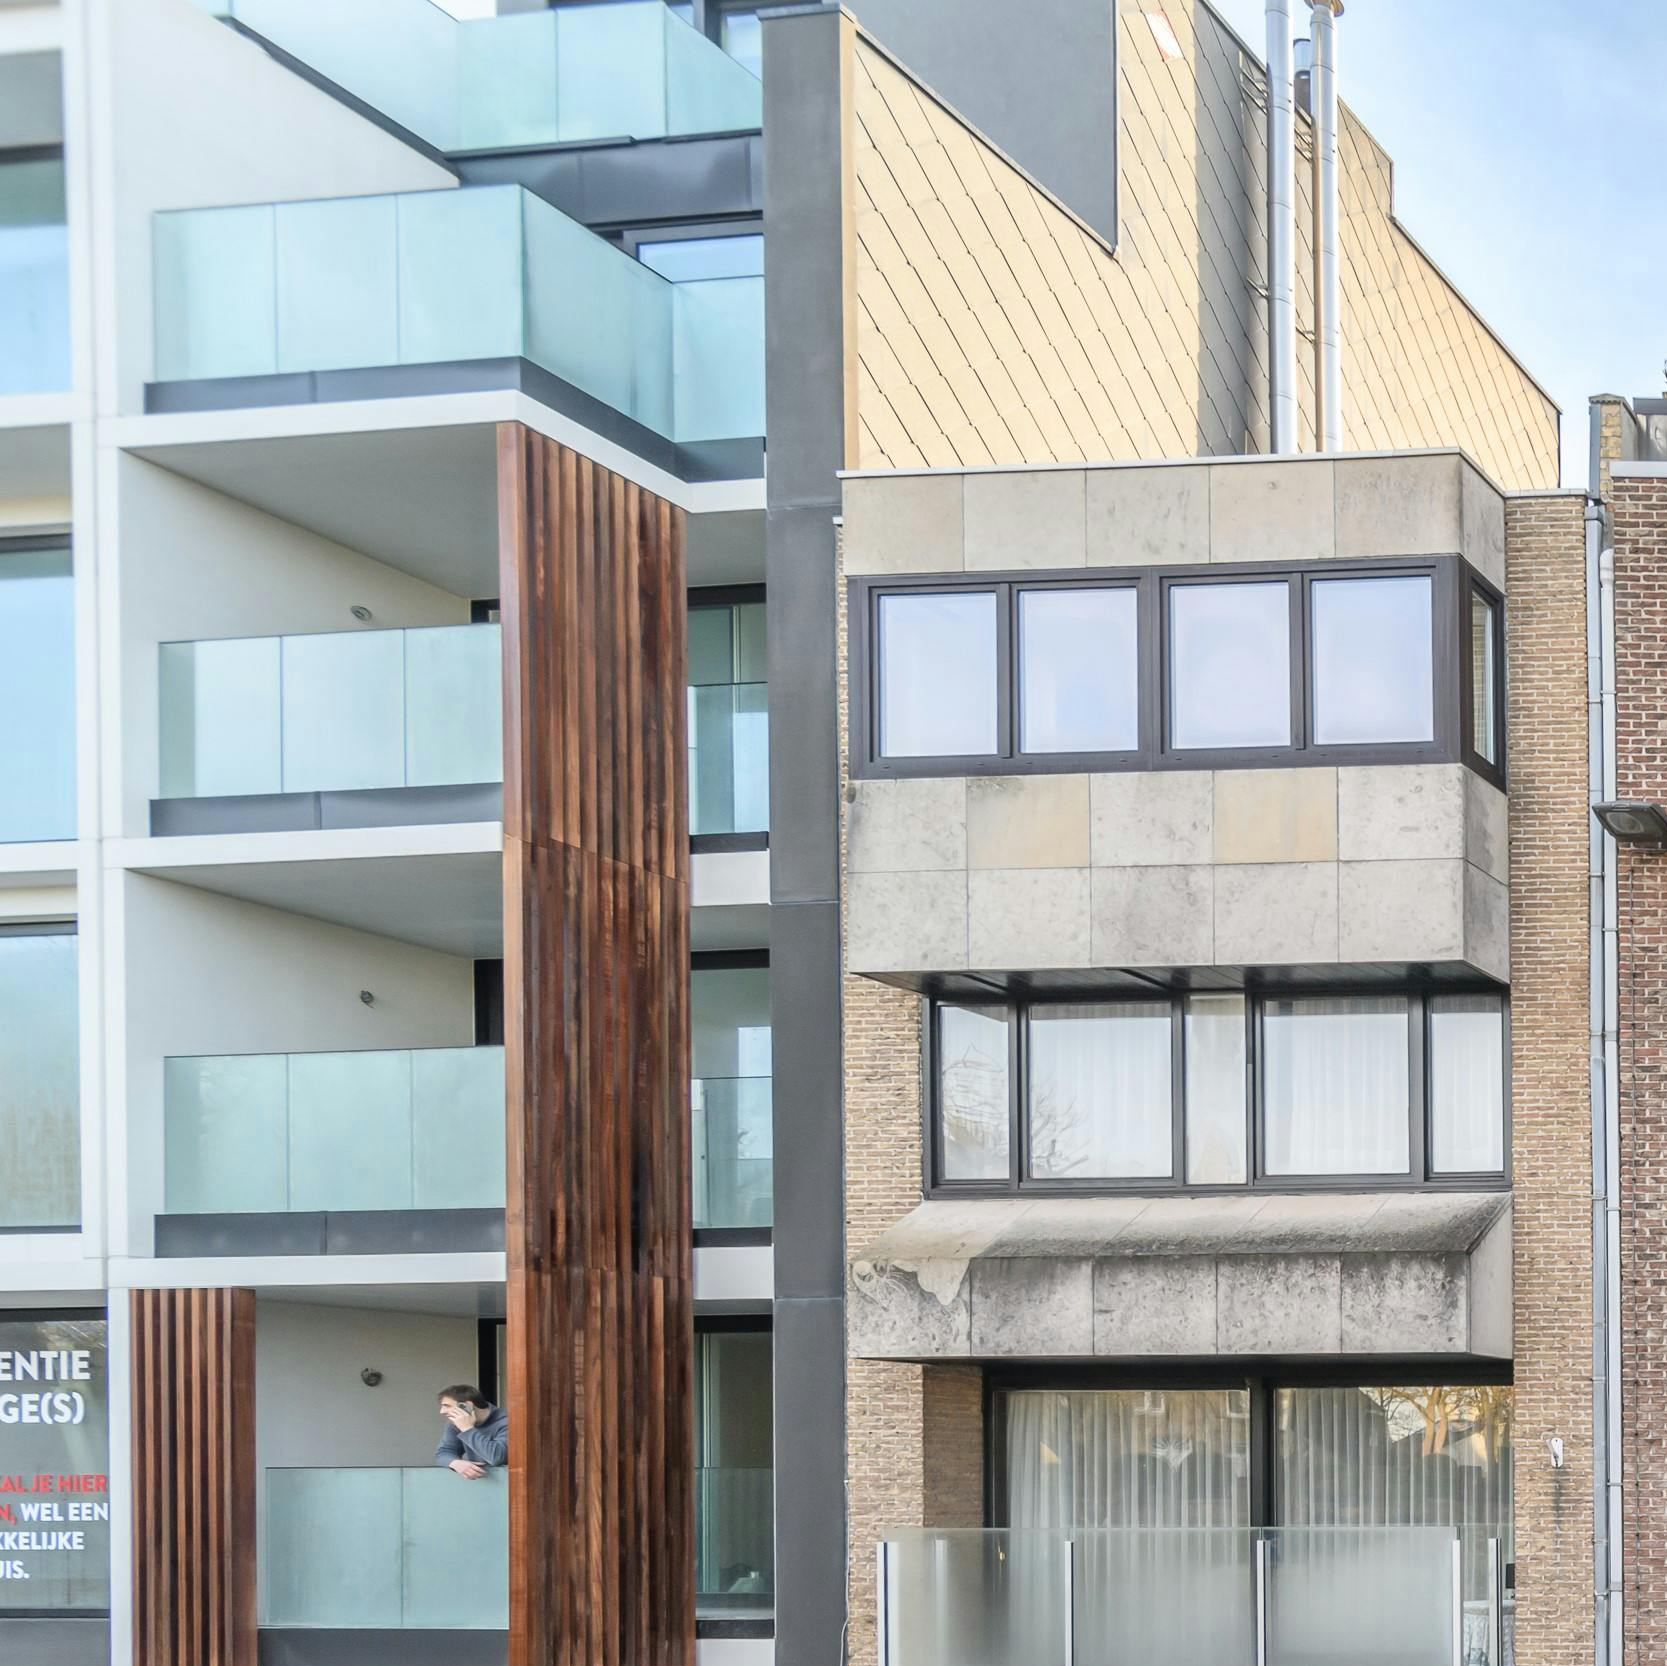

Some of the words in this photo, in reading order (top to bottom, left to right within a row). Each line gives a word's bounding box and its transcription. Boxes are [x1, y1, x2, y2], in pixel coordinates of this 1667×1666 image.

[31, 1475, 52, 1493] JE
[57, 1475, 107, 1493] HIER
[20, 1503, 64, 1522] WEL
[68, 1503, 108, 1522] EEN
